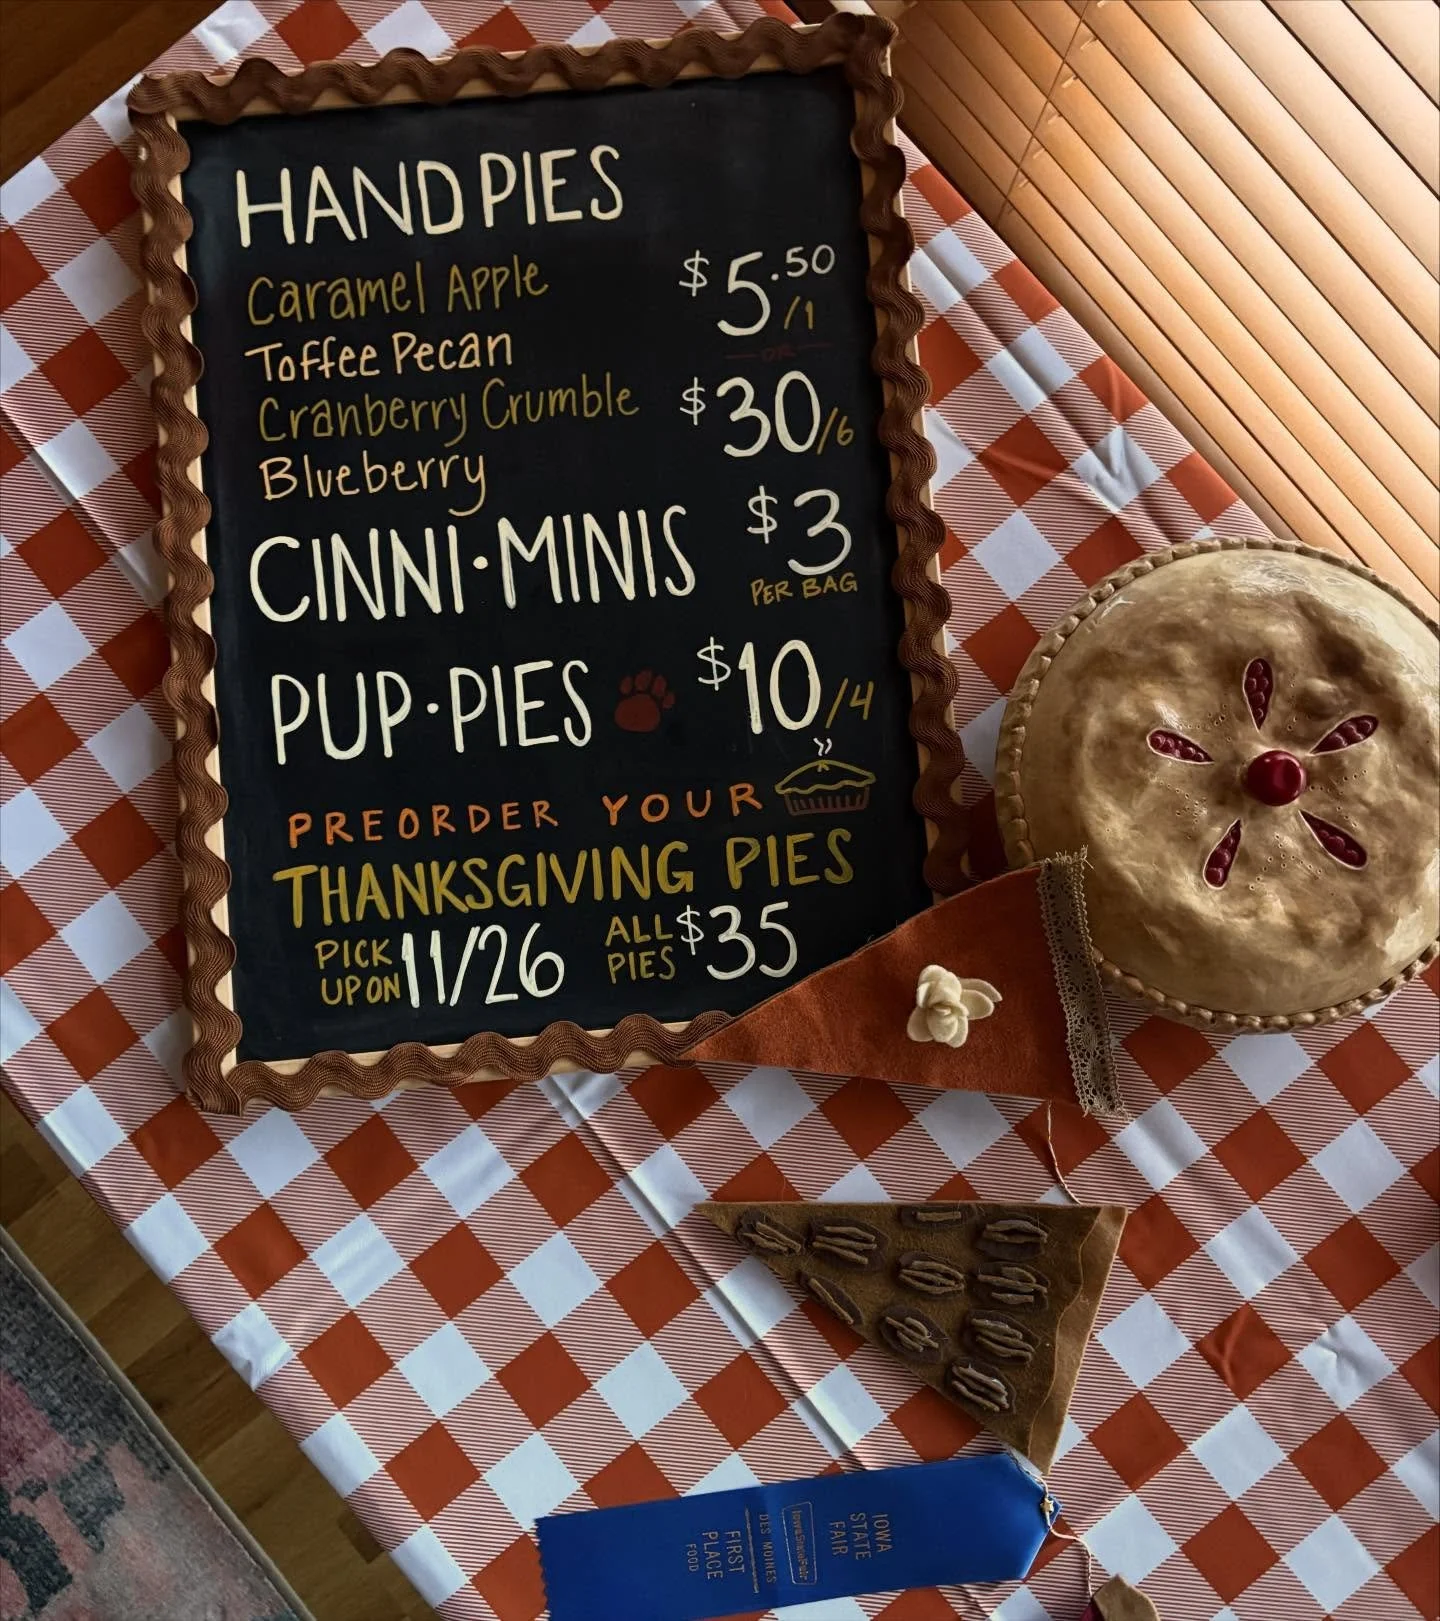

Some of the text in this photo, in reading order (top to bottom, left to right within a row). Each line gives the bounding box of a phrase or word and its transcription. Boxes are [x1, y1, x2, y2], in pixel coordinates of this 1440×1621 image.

[237, 145, 623, 248] HAND PIES
[248, 255, 549, 325] Caramel Apple
[245, 332, 513, 382] Toffee Pecan
[260, 372, 640, 447] Cranberry Crumble
[259, 452, 486, 517] Blueberry
[751, 573, 857, 605] PER BAG
[289, 783, 763, 848] PREORDER YOUR
[273, 828, 854, 929] THANKSGIVING PIES
[315, 939, 393, 970] PICK
[605, 915, 672, 945] ALL
[676, 901, 798, 980] $35
[401, 923, 565, 1008] 11/26
[608, 947, 675, 984] PIES
[687, 1543, 700, 1572] FOOD
[702, 1531, 724, 1580] PLACE
[726, 1530, 745, 1574] FIRST
[760, 1514, 777, 1584] DES MOINES
[831, 1521, 848, 1556] FAIR
[850, 1513, 873, 1560] STATE
[874, 1513, 892, 1554] IOWA
